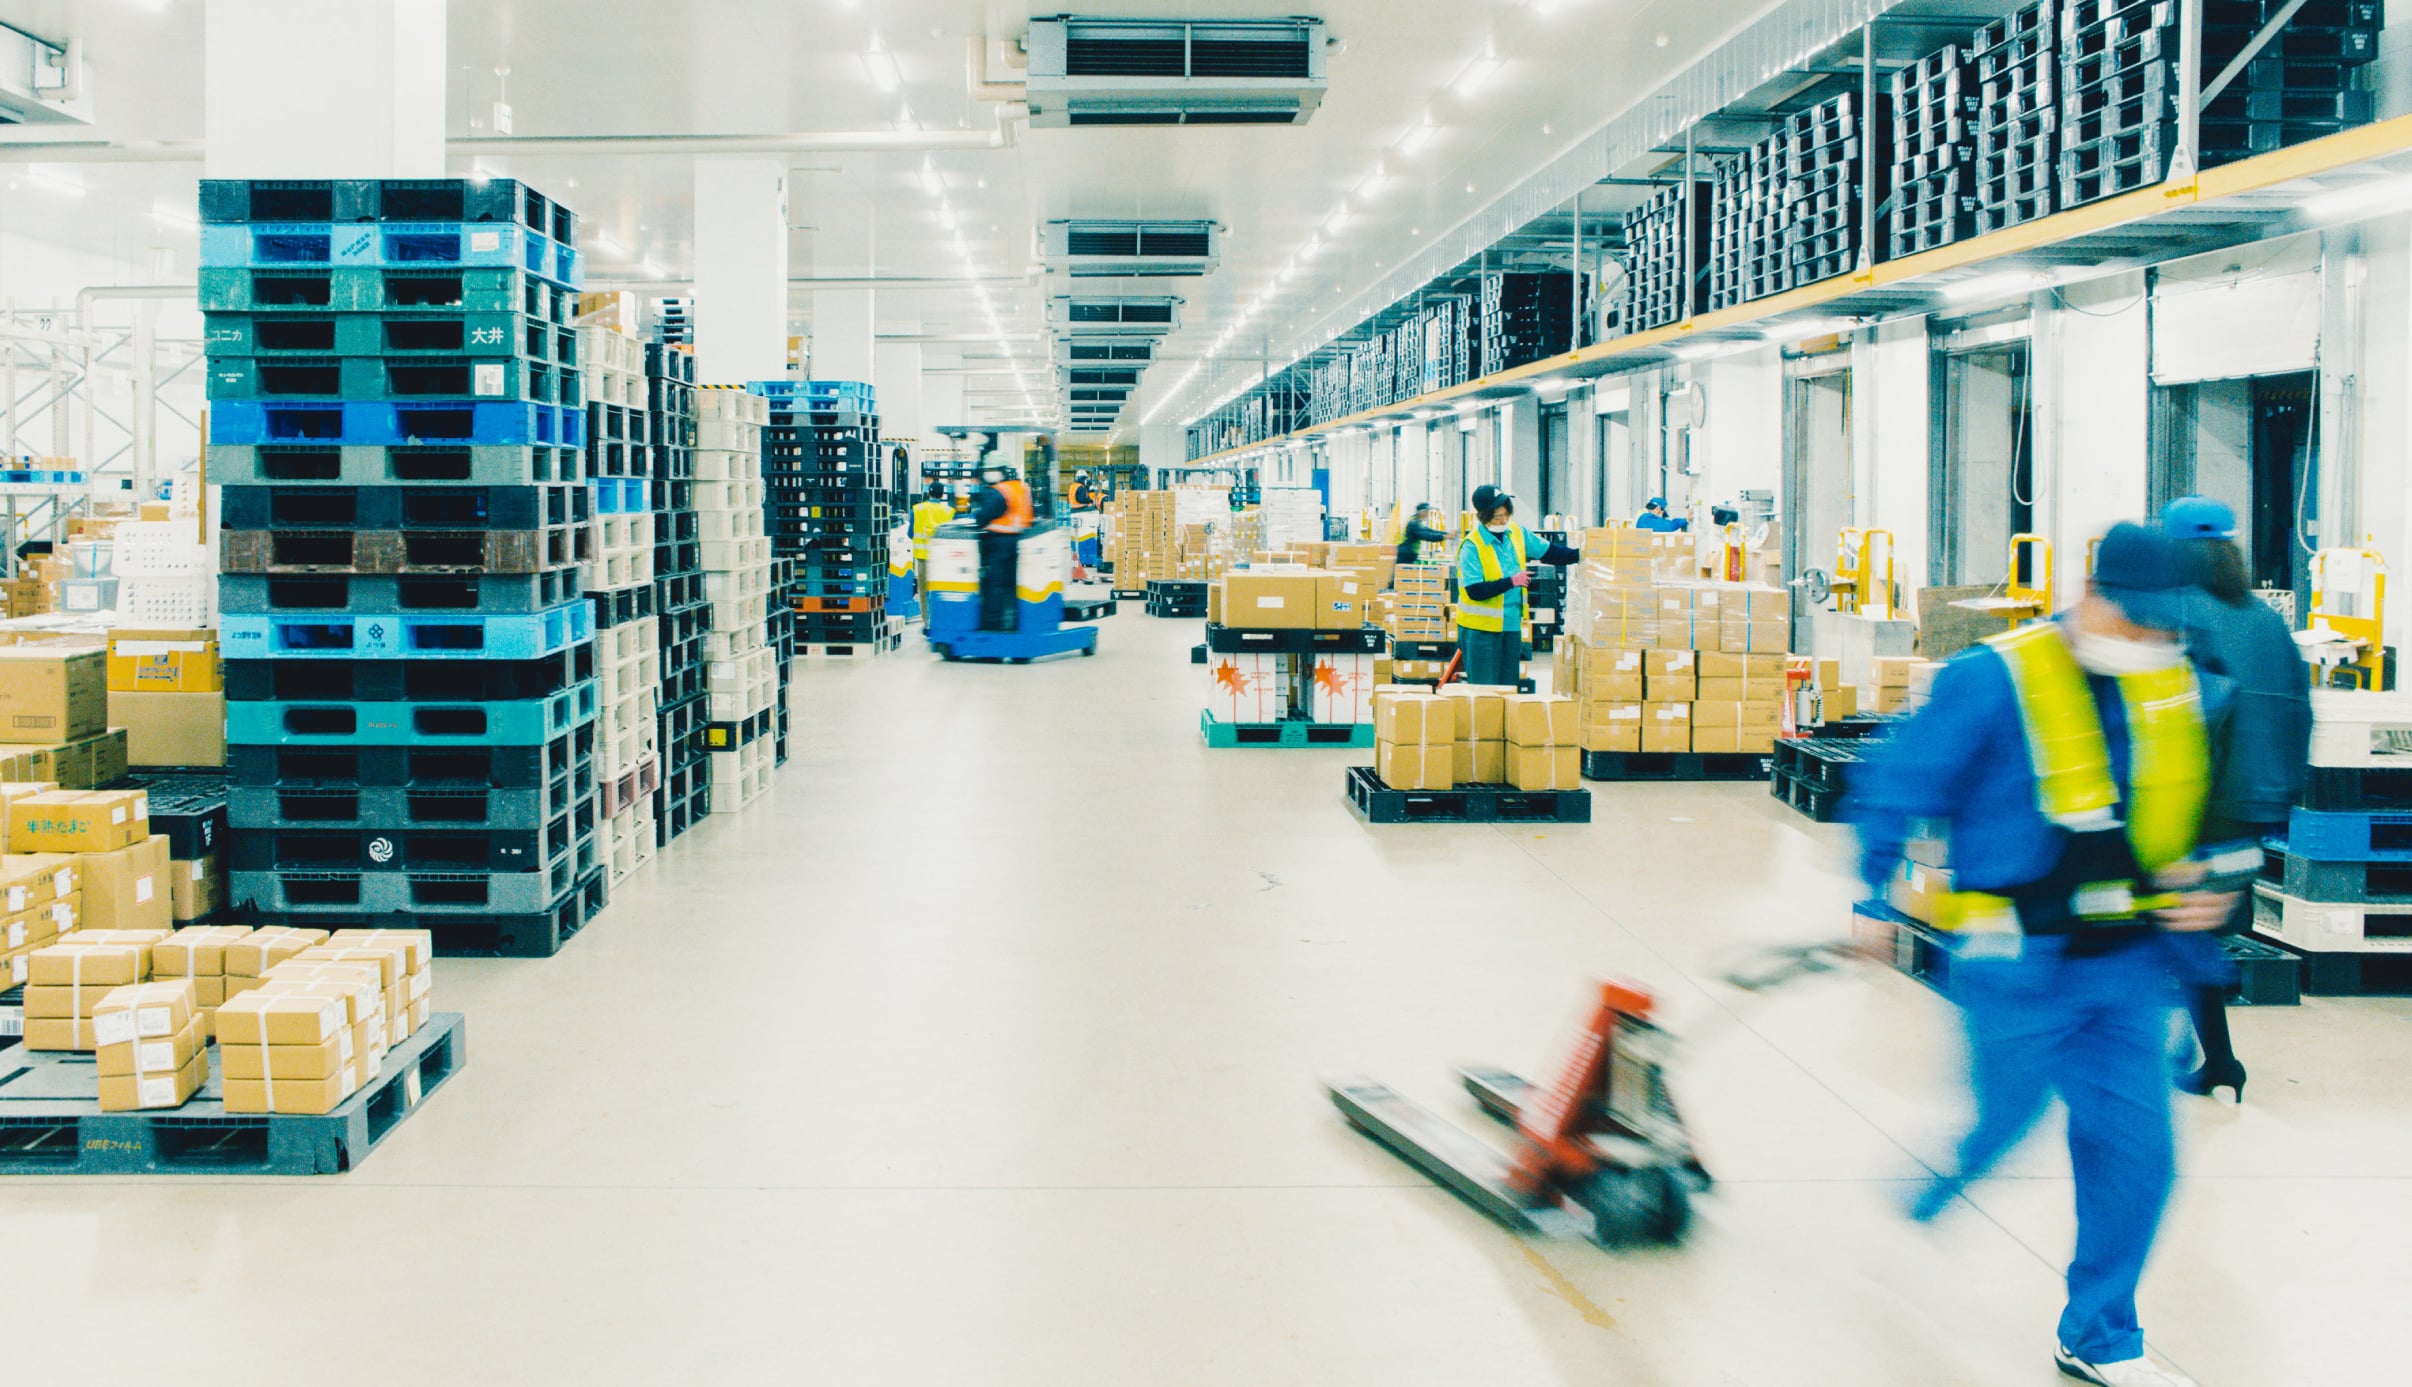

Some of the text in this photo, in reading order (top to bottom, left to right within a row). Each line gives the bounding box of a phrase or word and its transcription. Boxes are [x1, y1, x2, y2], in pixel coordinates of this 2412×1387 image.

[471, 327, 504, 345] 大井
[26, 818, 92, 835] 半熟たまご
